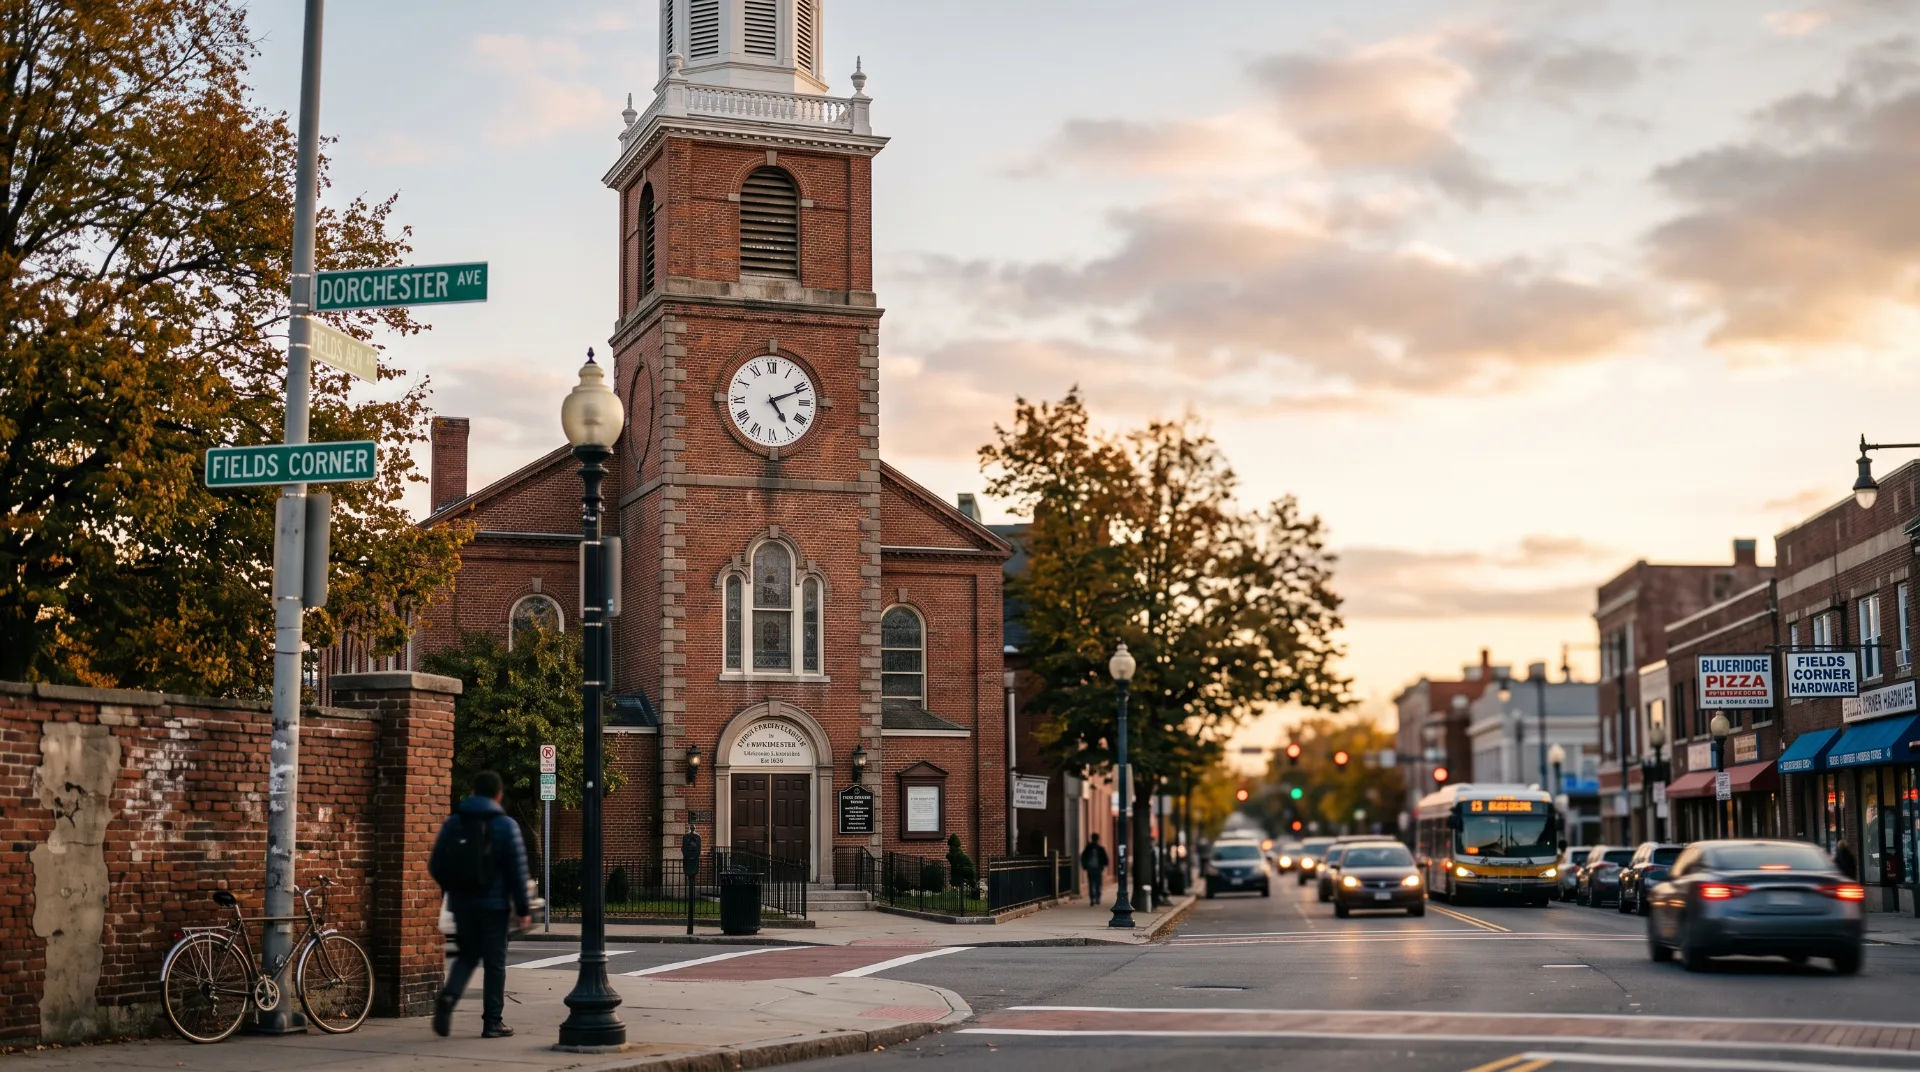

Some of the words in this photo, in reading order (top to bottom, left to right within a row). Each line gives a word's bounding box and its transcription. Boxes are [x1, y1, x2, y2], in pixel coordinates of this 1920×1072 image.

[319, 270, 449, 305] DORCHESTER
[457, 269, 482, 287] AVE
[212, 453, 279, 480] FIELDS
[288, 449, 368, 477] CORNER
[1701, 659, 1769, 673] BLUERIDGE
[1797, 656, 1846, 667] FIELDS
[1706, 674, 1766, 688] PIZZA
[1793, 668, 1851, 681] CORNER
[1791, 681, 1855, 694] HARDWARE
